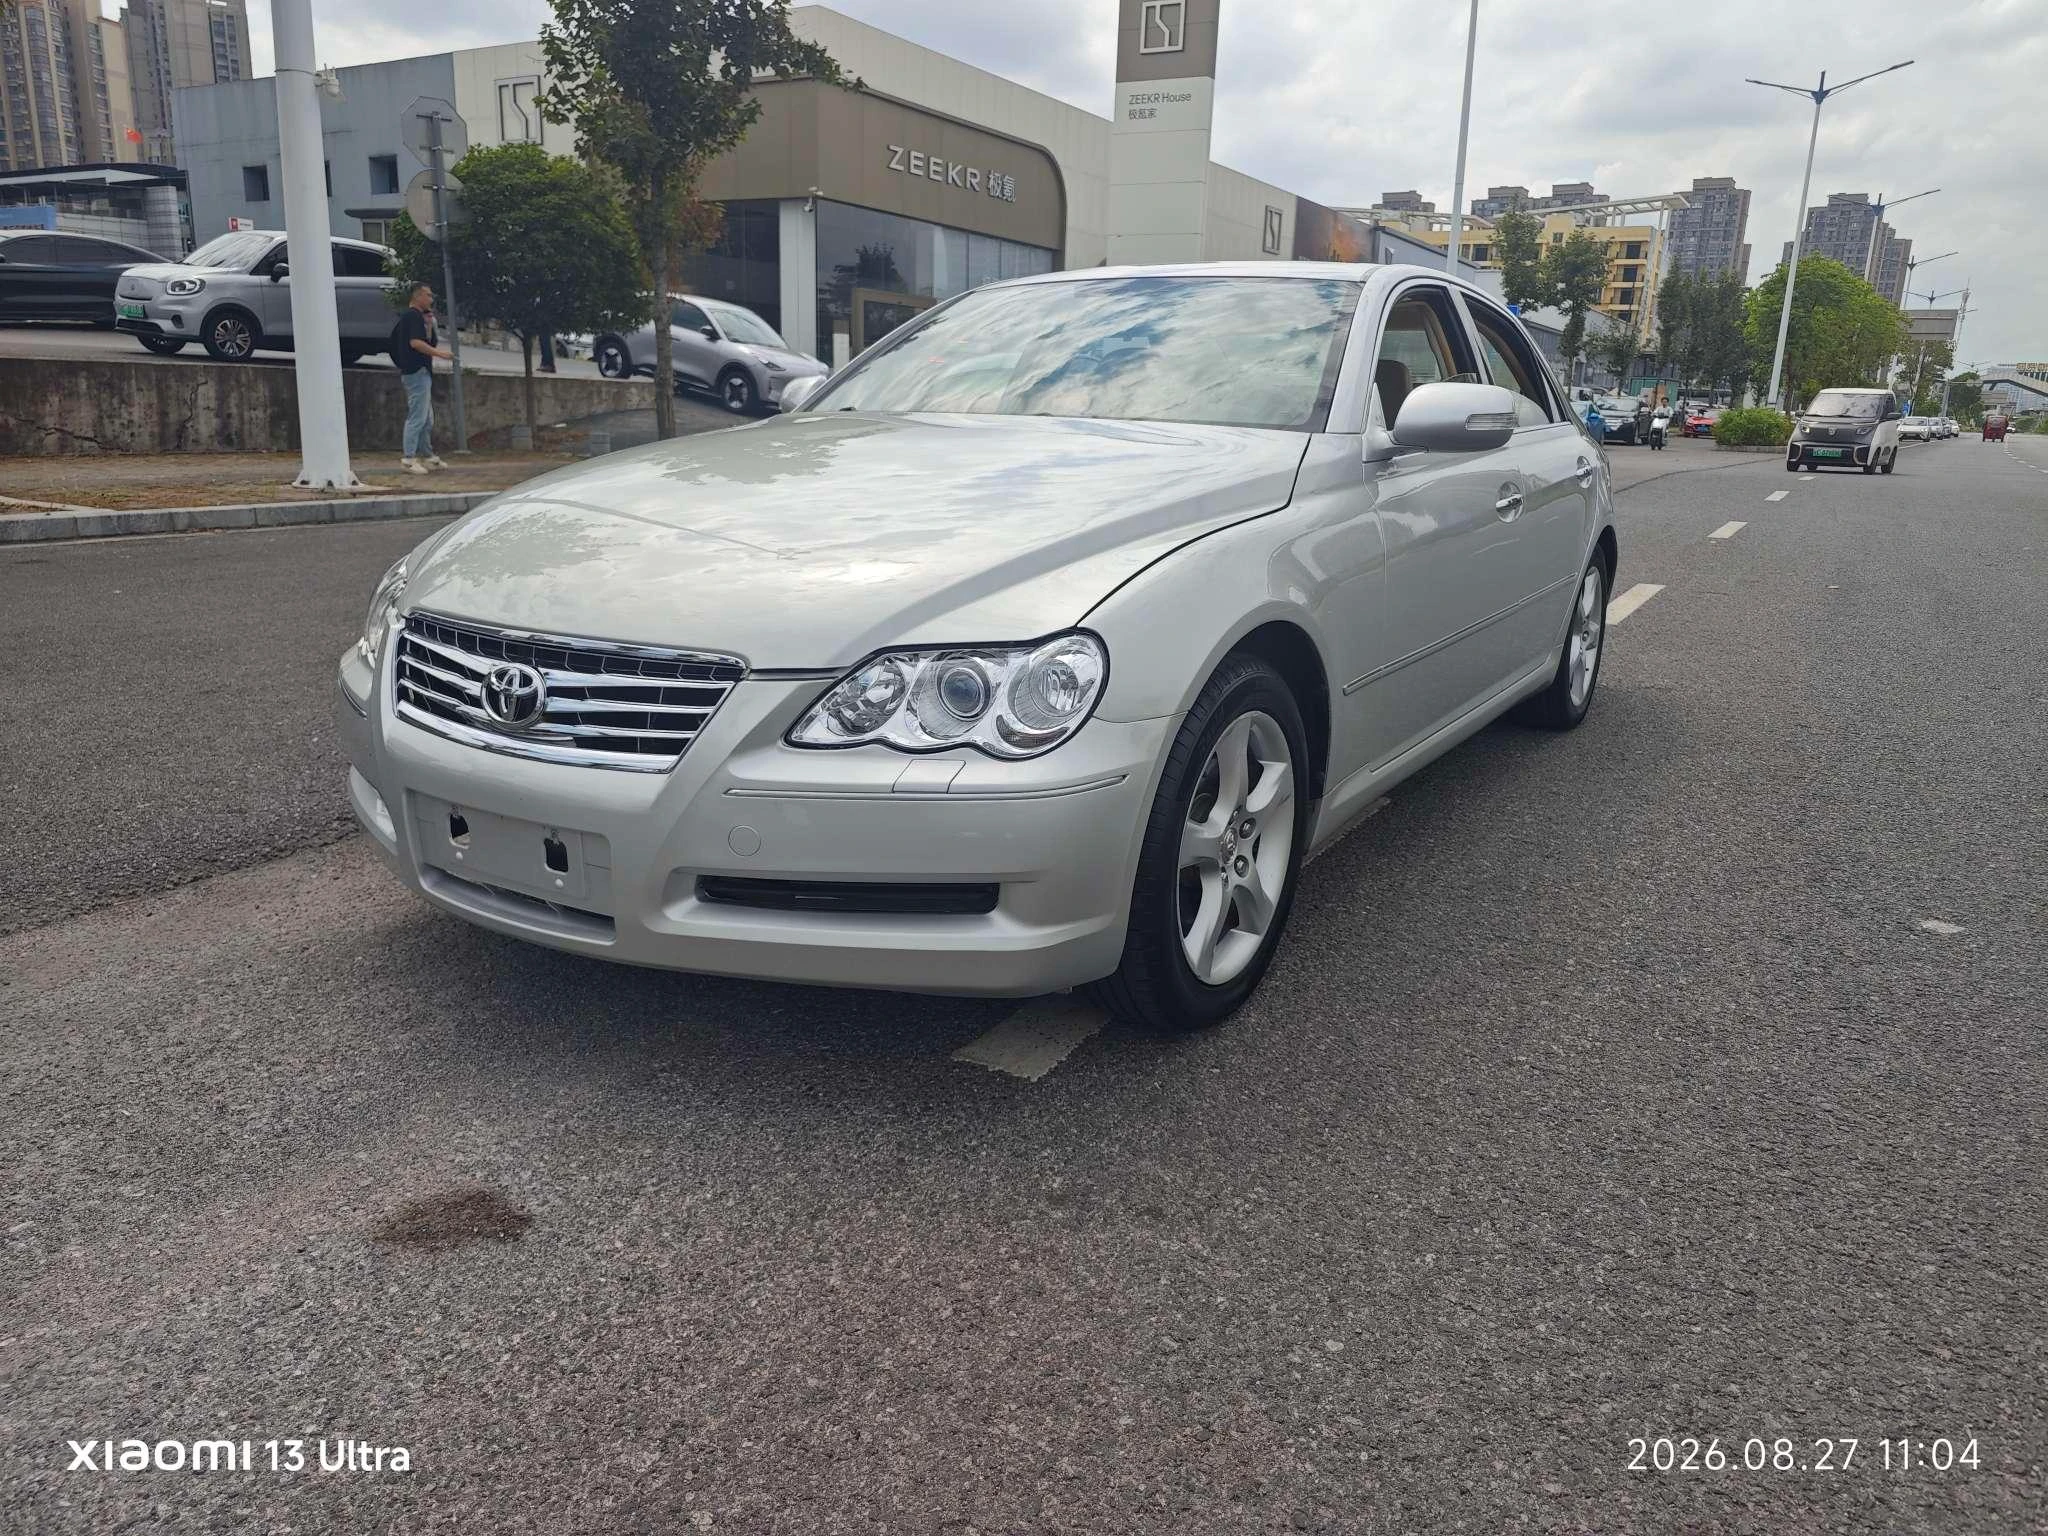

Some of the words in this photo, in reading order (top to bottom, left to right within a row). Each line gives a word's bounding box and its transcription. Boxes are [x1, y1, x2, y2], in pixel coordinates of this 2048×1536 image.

[1128, 93, 1160, 105] ZEEKR
[1162, 92, 1192, 103] House
[887, 144, 981, 192] ZEEKR
[987, 169, 1017, 203] 极氪
